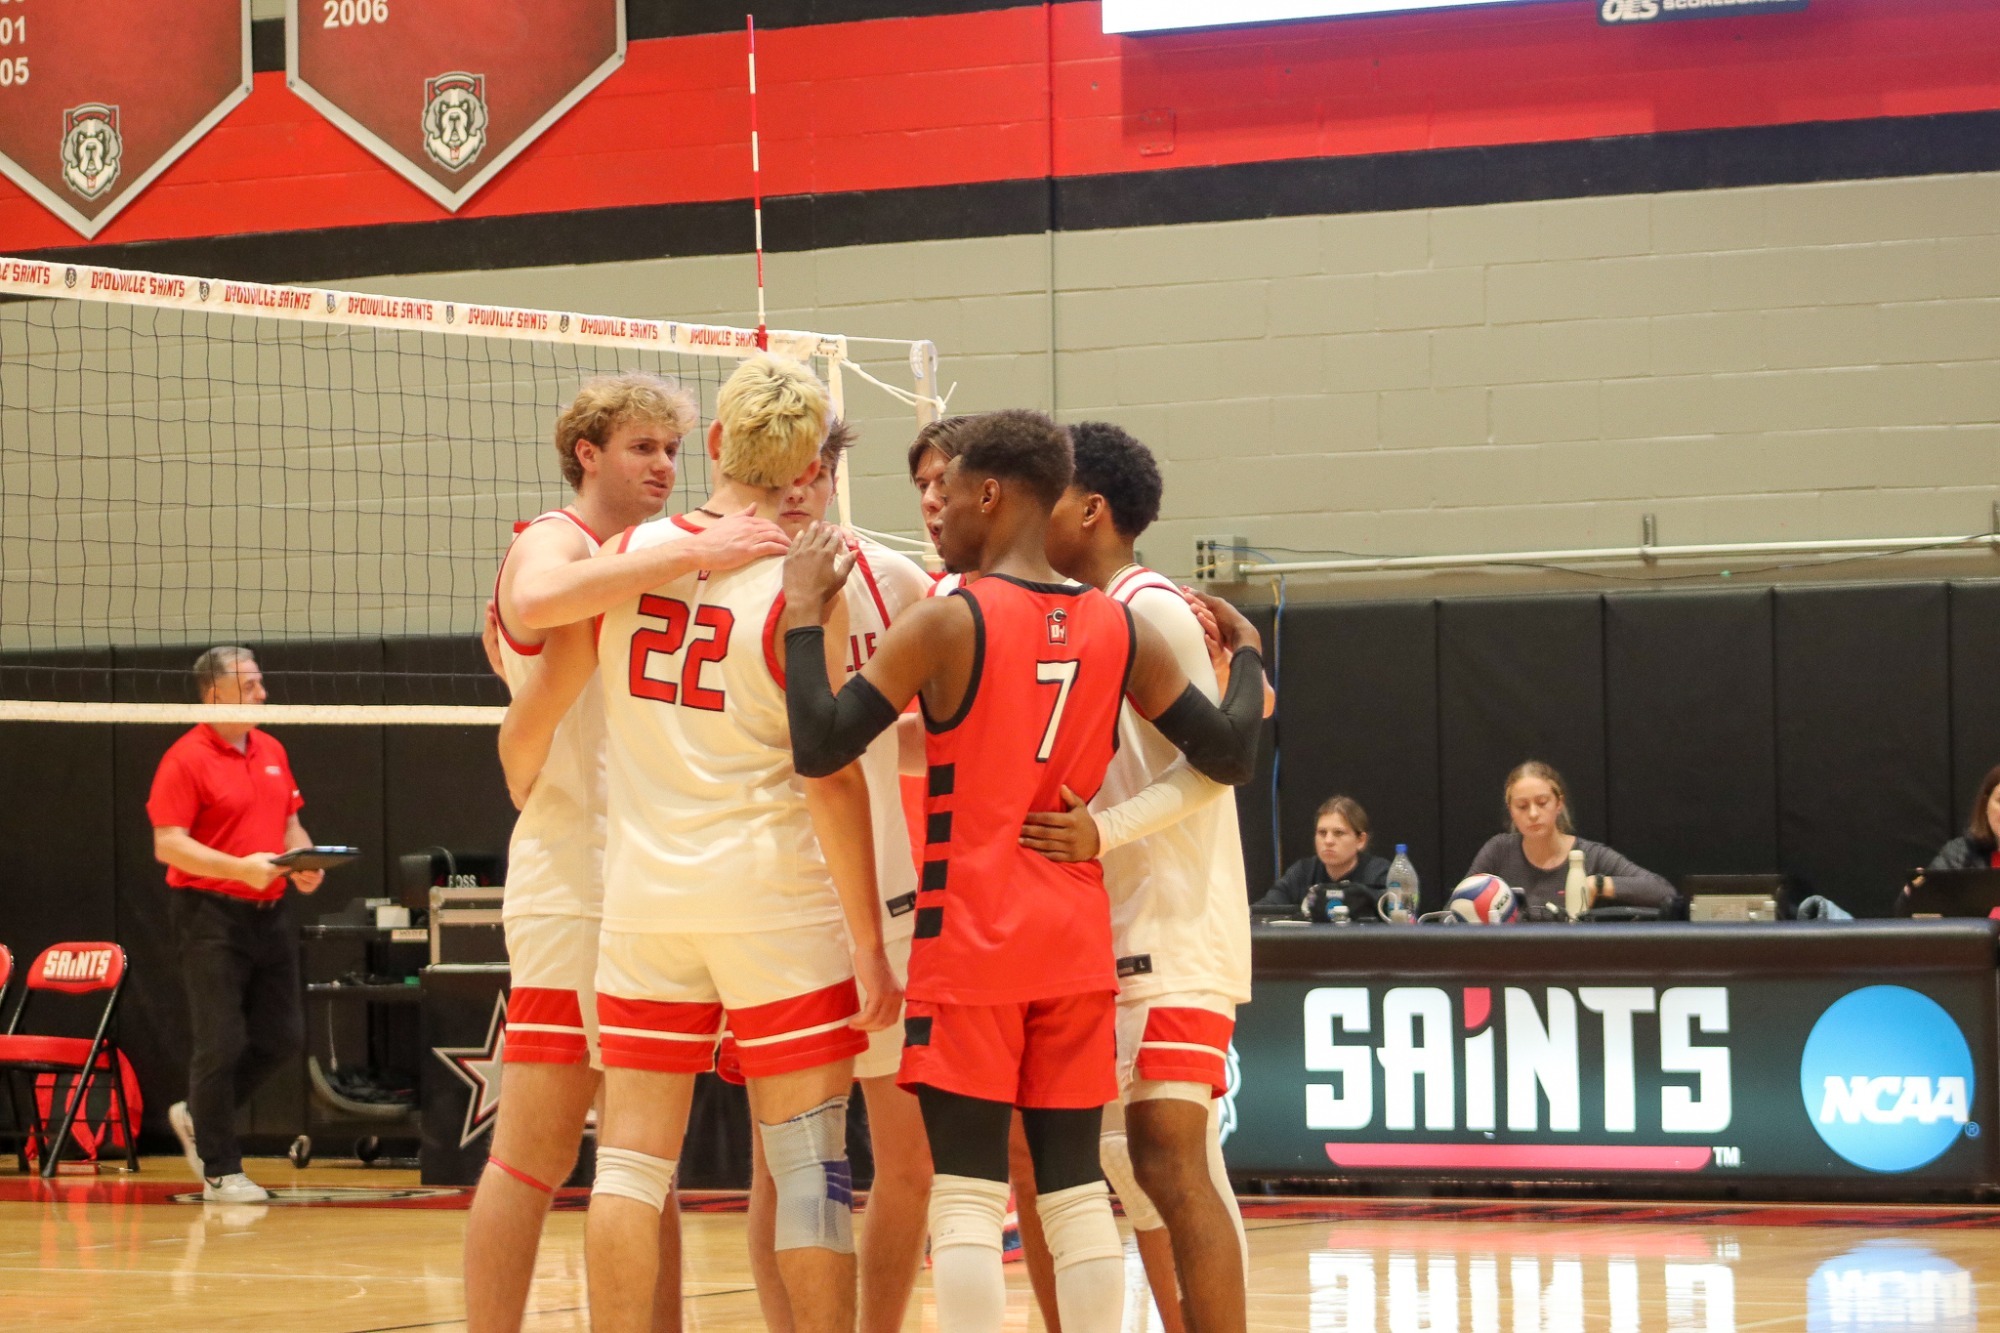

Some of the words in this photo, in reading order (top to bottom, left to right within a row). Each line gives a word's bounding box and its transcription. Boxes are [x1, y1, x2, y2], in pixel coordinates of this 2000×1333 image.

[323, 0, 389, 29] 2006
[629, 593, 735, 712] 22
[1036, 659, 1080, 762] 7
[1819, 1075, 1970, 1124] NCAA
